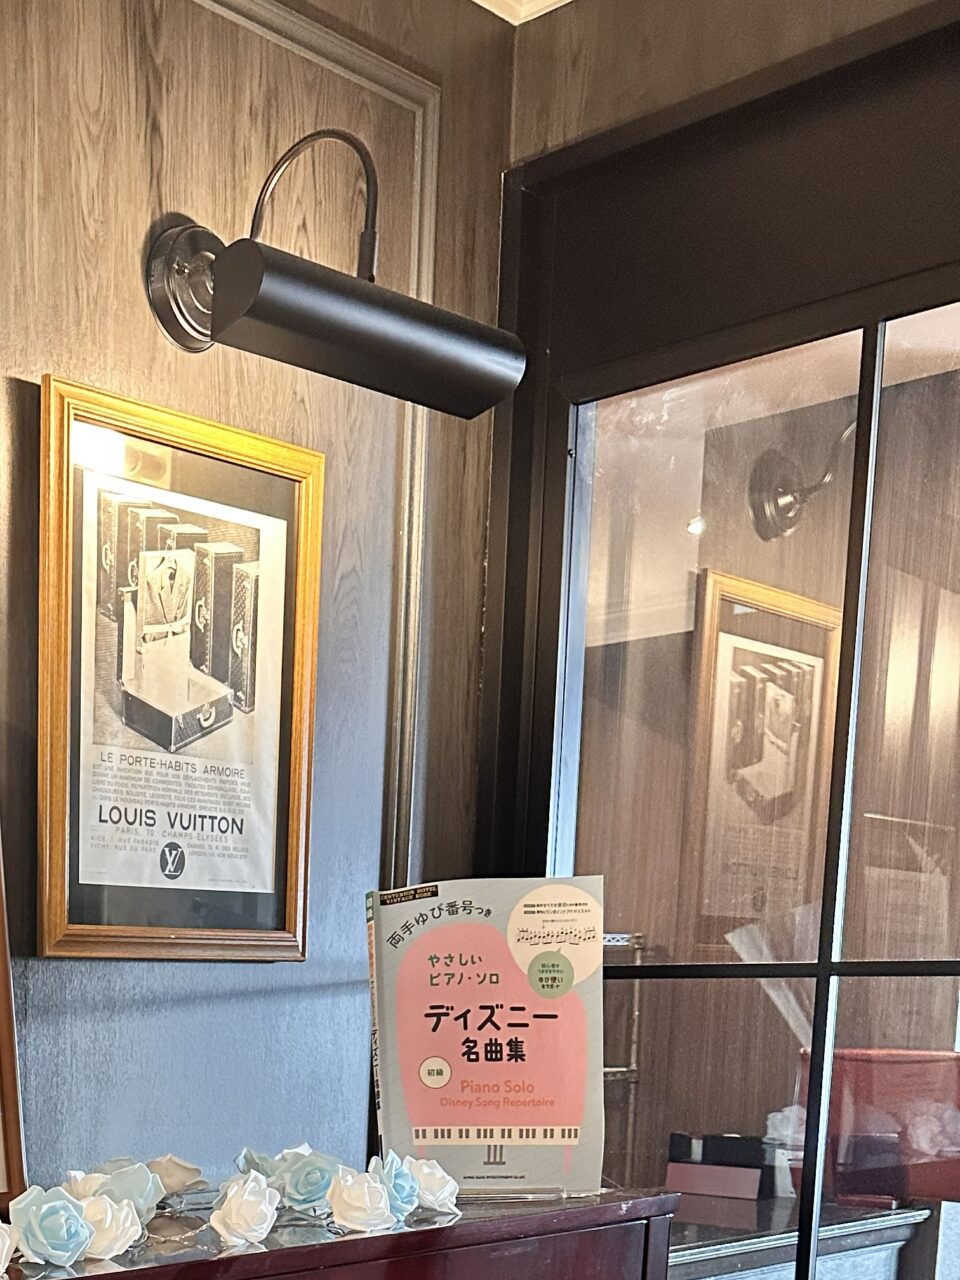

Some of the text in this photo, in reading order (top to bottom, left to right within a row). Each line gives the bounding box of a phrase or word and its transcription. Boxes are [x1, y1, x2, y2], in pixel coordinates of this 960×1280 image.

[100, 751, 245, 779] LE PORTE-HABITS ARMOIRE
[98, 805, 244, 835] LOUIS VUITTON
[386, 900, 493, 949] 両手ゆび番号つき
[428, 953, 483, 967] やさしい
[429, 972, 500, 987] ピアノ・ソロ
[424, 1003, 558, 1033] ディズニー
[461, 1037, 526, 1063] 名曲集
[427, 1068, 444, 1077] 初級
[460, 1080, 535, 1094] Piano Solo
[440, 1097, 555, 1108] Disney Song Repertoire
